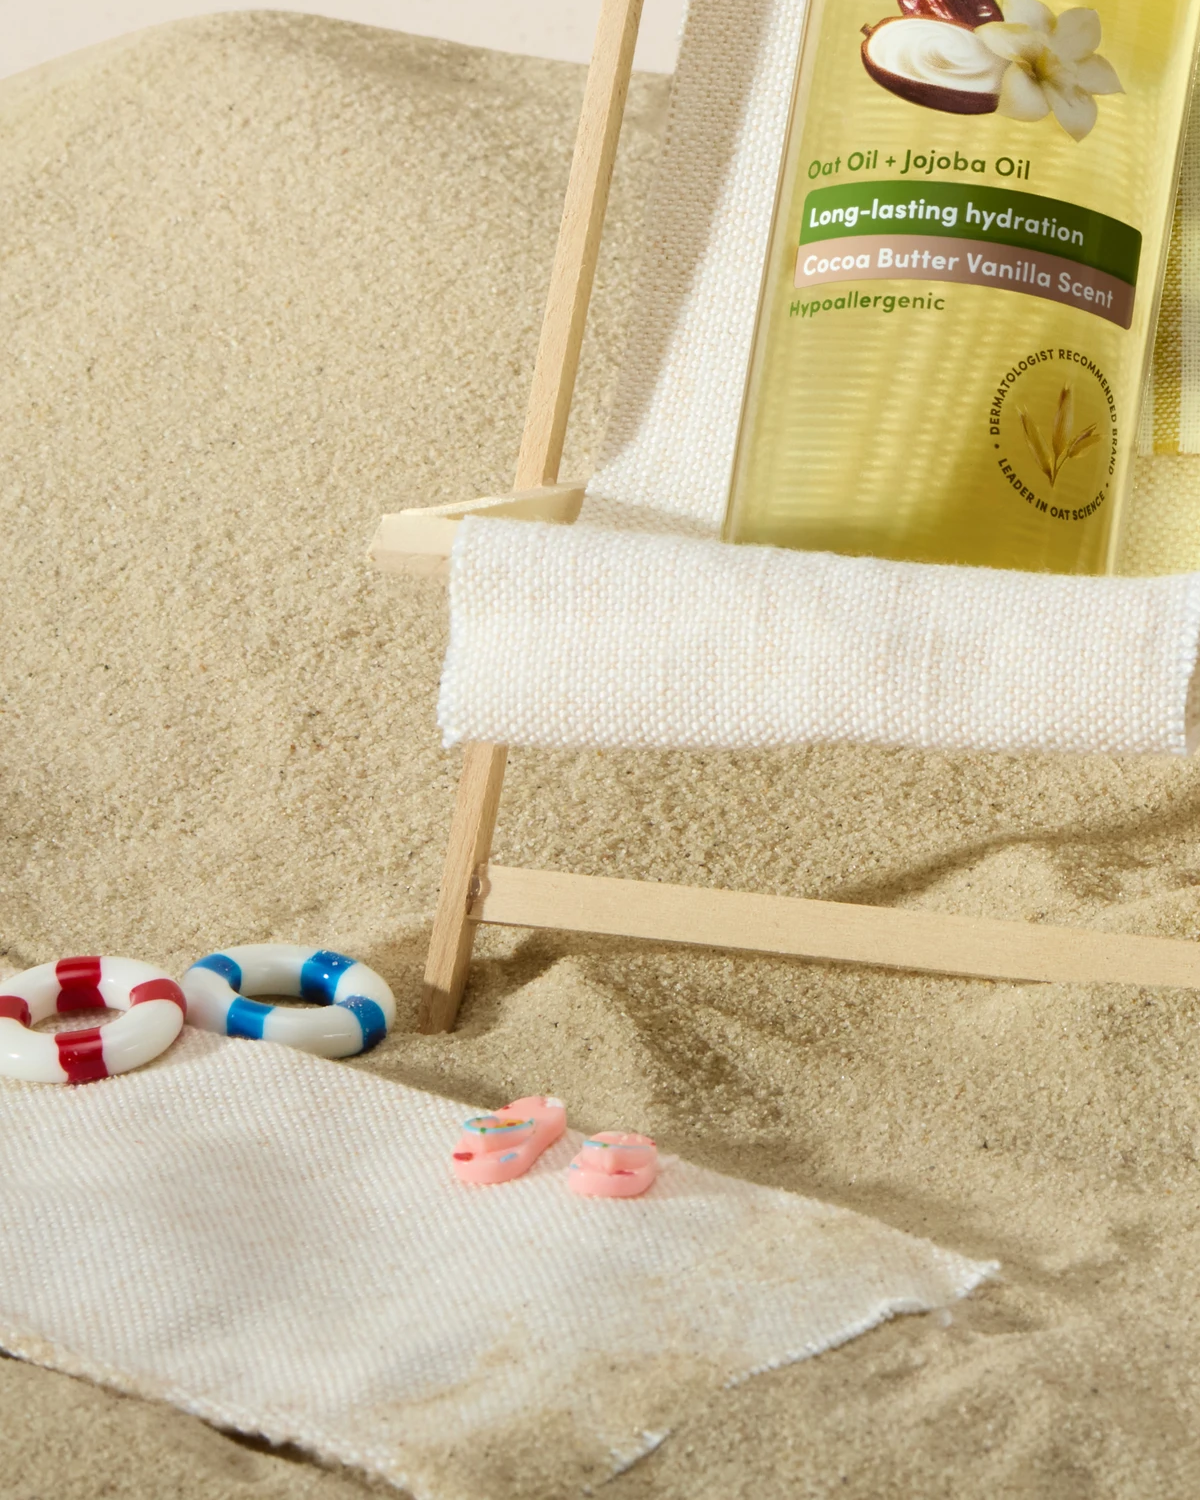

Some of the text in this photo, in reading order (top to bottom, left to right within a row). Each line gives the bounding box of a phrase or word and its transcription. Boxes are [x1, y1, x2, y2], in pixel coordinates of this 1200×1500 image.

[807, 149, 1031, 180] Oat Oil + Jojoba Oil
[809, 198, 1084, 247] Long-lasting hydration
[789, 291, 946, 318] Hypoallergenic
[803, 247, 1114, 309] Cocoa Butter Vanilla Scent
[989, 348, 1118, 475] DERMATOLOGIST RECOMMENDED BRAND
[998, 458, 1106, 521] LEADER IN OAT SCIENCE
